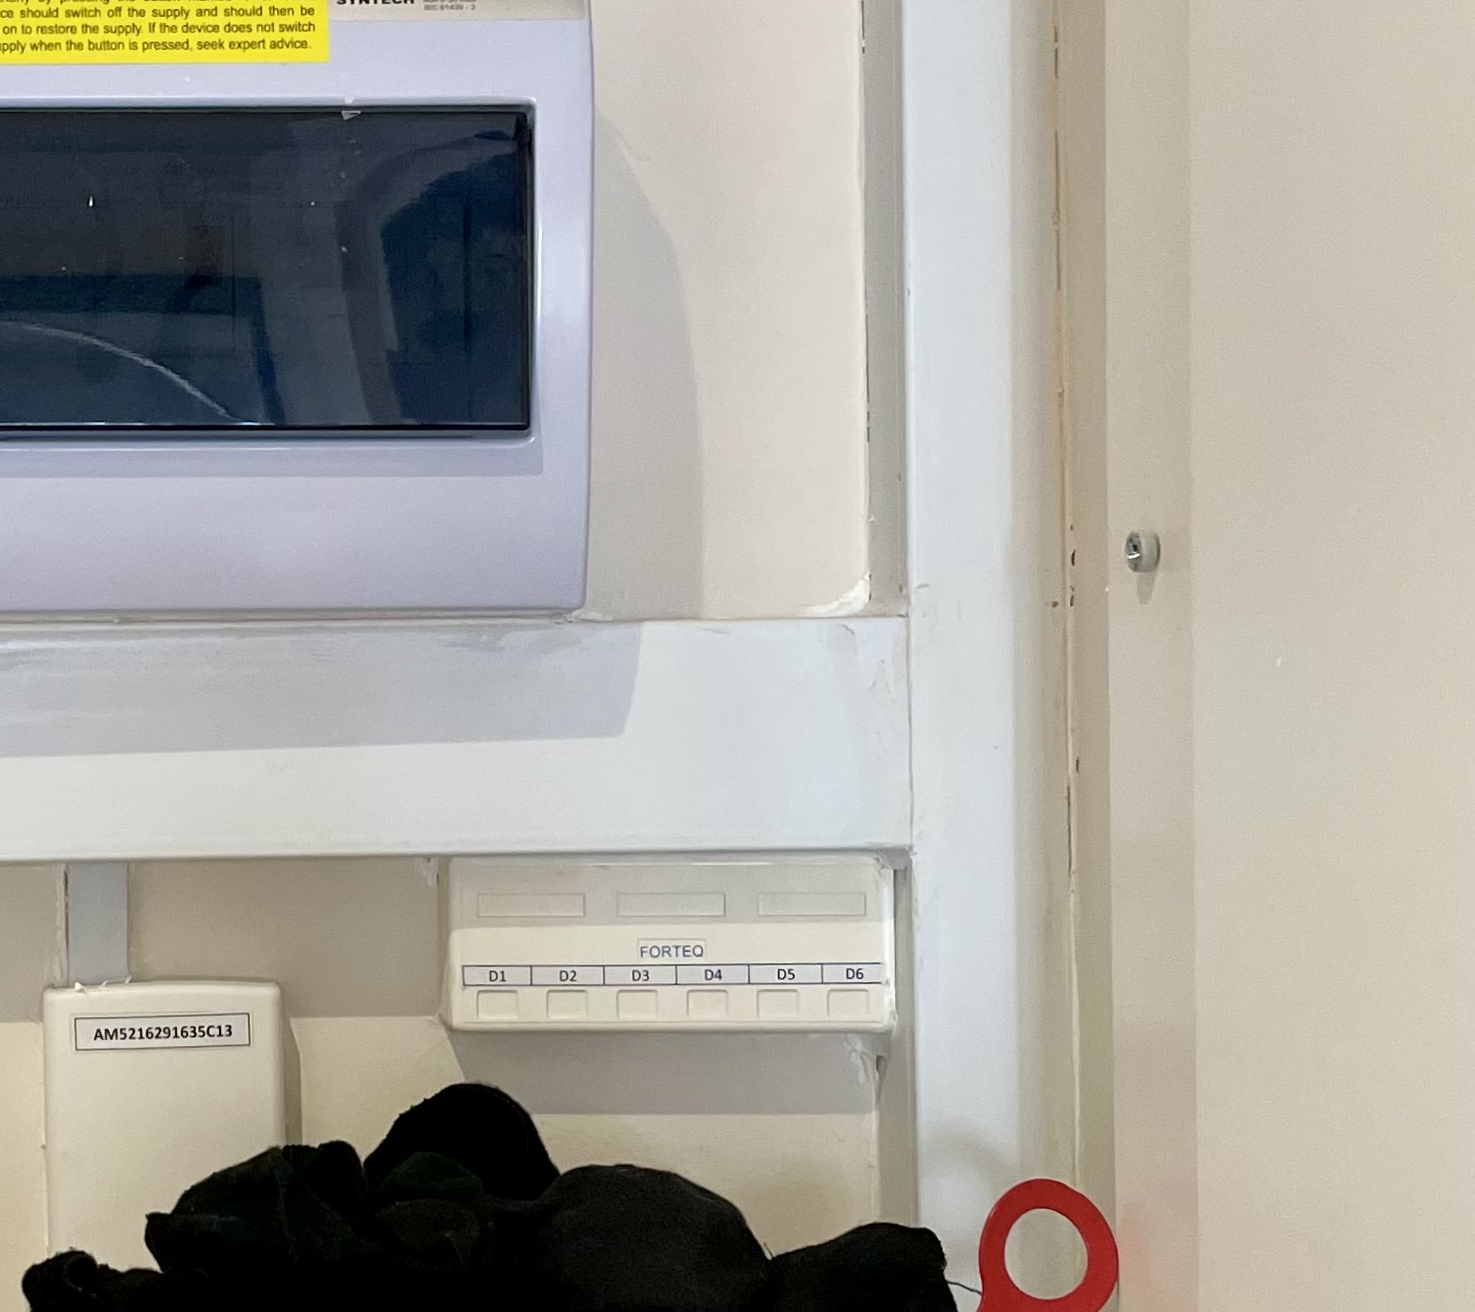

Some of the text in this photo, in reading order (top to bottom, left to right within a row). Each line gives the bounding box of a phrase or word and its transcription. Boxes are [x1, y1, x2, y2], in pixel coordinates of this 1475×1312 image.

[20, 7, 59, 19] should
[65, 7, 101, 18] switch
[107, 6, 122, 17] off
[128, 6, 146, 17] the
[151, 6, 190, 20] supply
[196, 6, 218, 17] and
[224, 6, 263, 17] should
[268, 5, 295, 17] then
[300, 5, 315, 16] be
[3, 26, 17, 34] on
[21, 24, 32, 34] to
[36, 24, 77, 34] restore
[81, 23, 100, 34] the
[148, 22, 156, 33] If
[159, 22, 178, 33] the
[181, 22, 220, 33] device
[224, 22, 253, 33] does
[256, 22, 275, 33] not
[279, 21, 316, 32] switch
[30, 40, 62, 51] when
[66, 40, 84, 51] the
[88, 39, 125, 51] button
[129, 39, 138, 51] is
[197, 39, 225, 50] seek
[229, 39, 266, 52] expert
[640, 945, 704, 959] FORTEQ
[488, 968, 864, 982] D1 D2 D3 D4 D5 D6
[93, 1024, 233, 1041] AM5216291635C13
